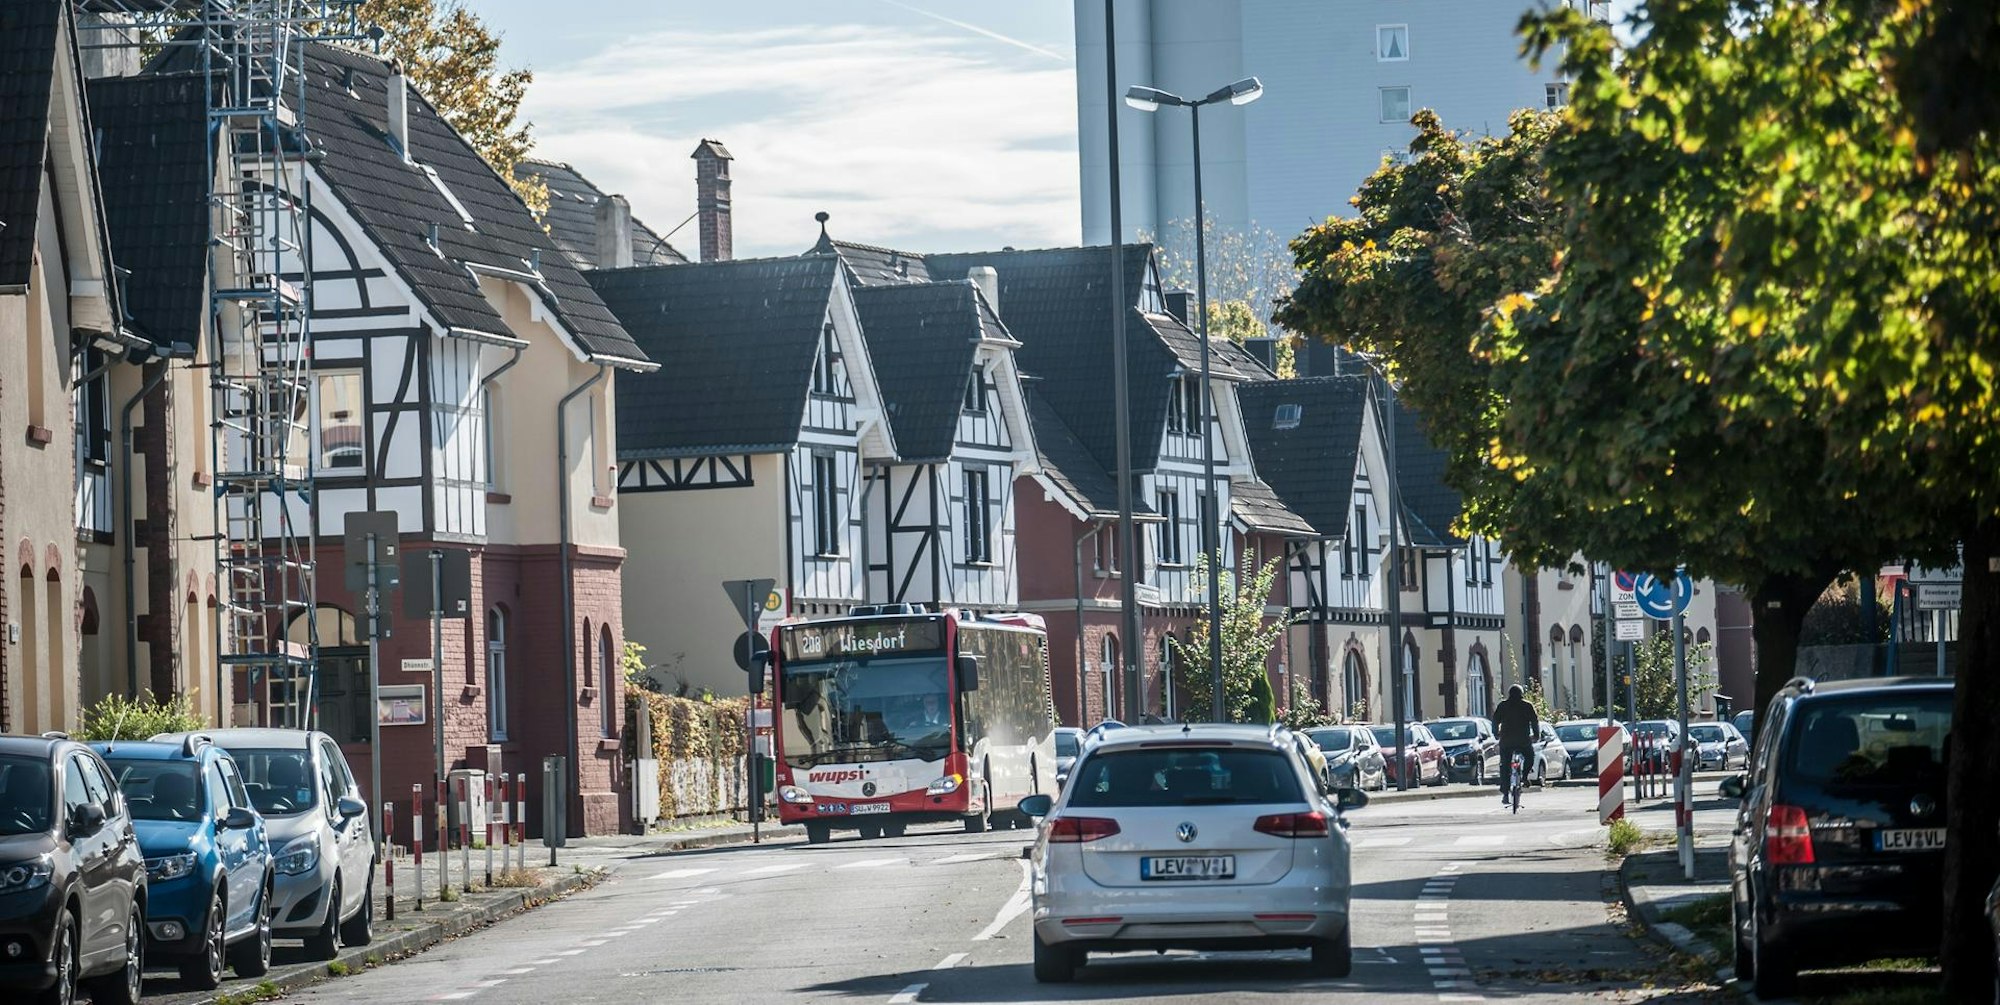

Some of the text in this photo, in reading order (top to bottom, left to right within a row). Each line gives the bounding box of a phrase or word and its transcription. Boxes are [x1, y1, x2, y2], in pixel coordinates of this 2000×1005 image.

[802, 630, 906, 653] 208 Wiesdorf
[809, 769, 865, 785] wupsi
[1884, 831, 1914, 848] LEV
[1155, 859, 1185, 874] LEV
